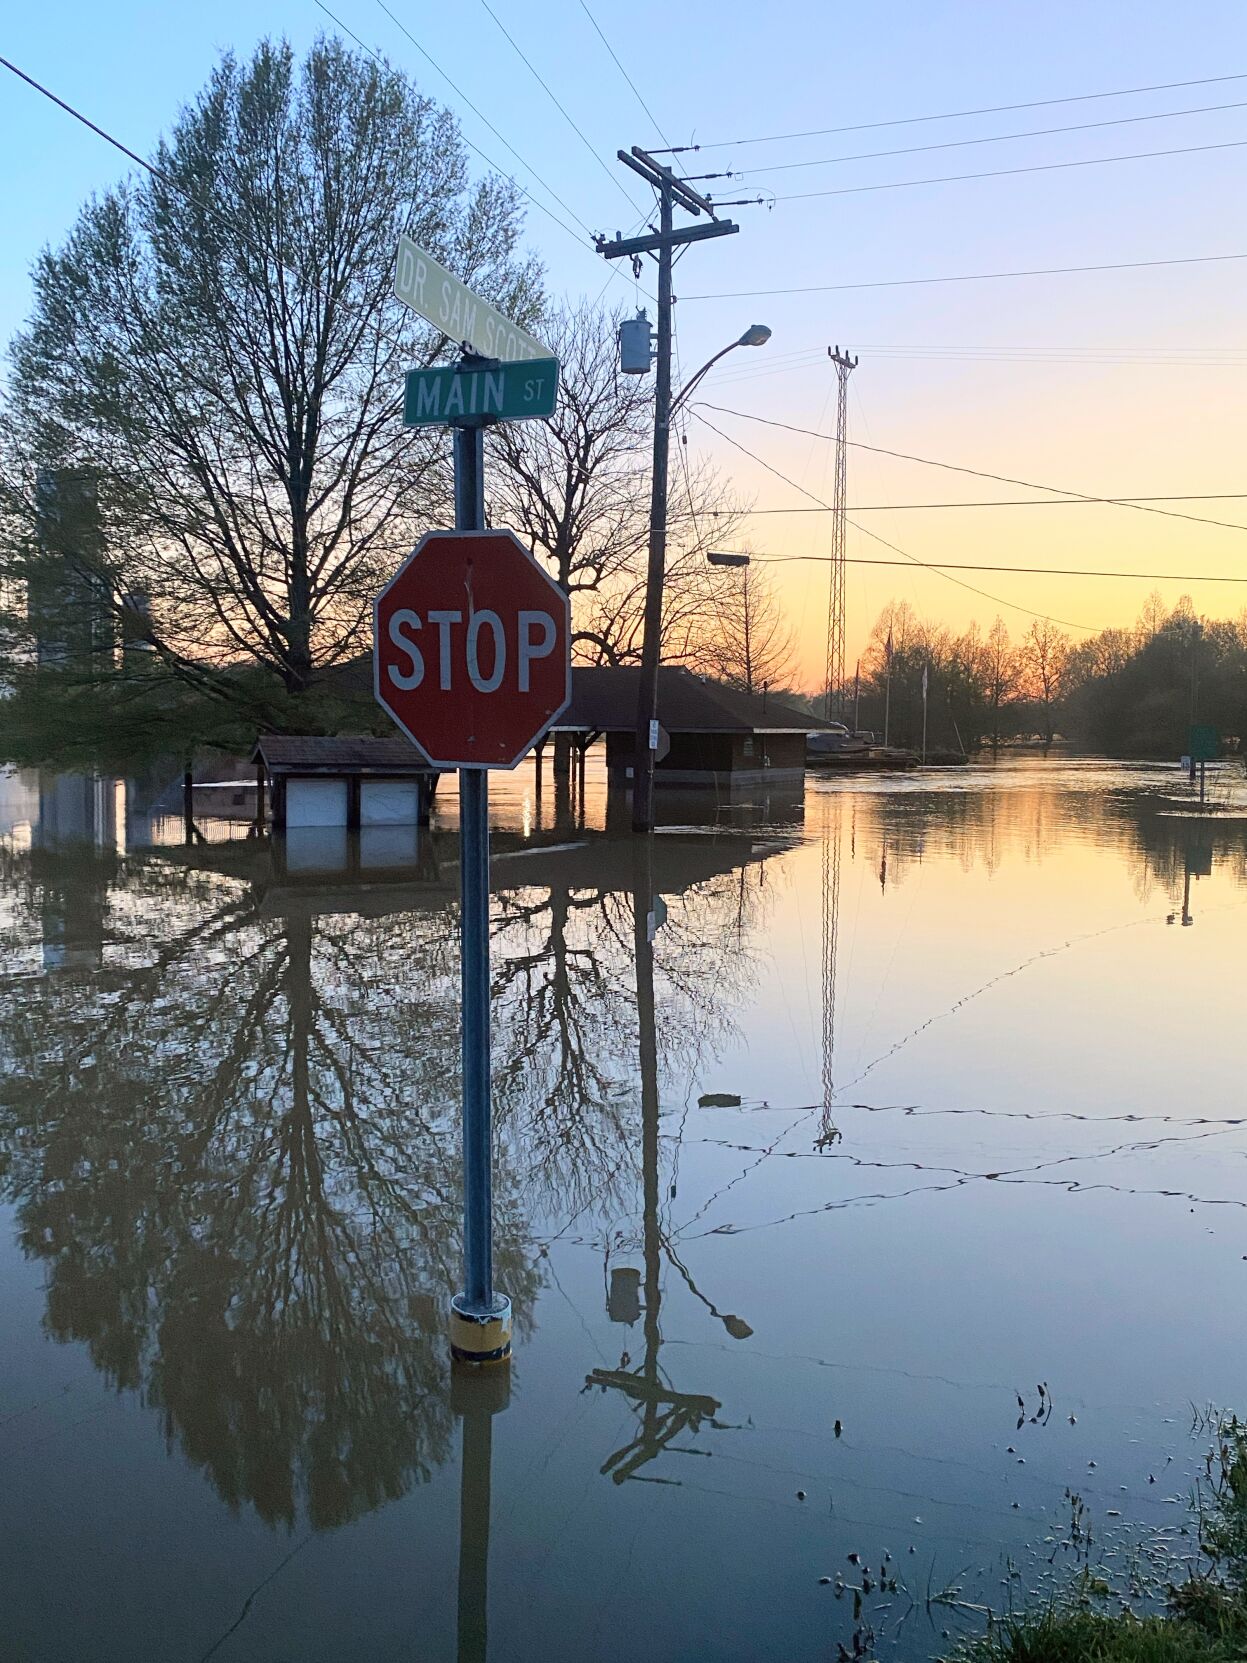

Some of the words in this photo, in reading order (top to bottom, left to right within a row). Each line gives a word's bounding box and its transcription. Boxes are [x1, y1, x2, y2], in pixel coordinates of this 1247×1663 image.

[400, 247, 428, 309] DR.
[440, 280, 477, 343] SAM
[415, 371, 506, 417] MAIN
[523, 378, 545, 402] ST
[387, 608, 557, 694] STOP
